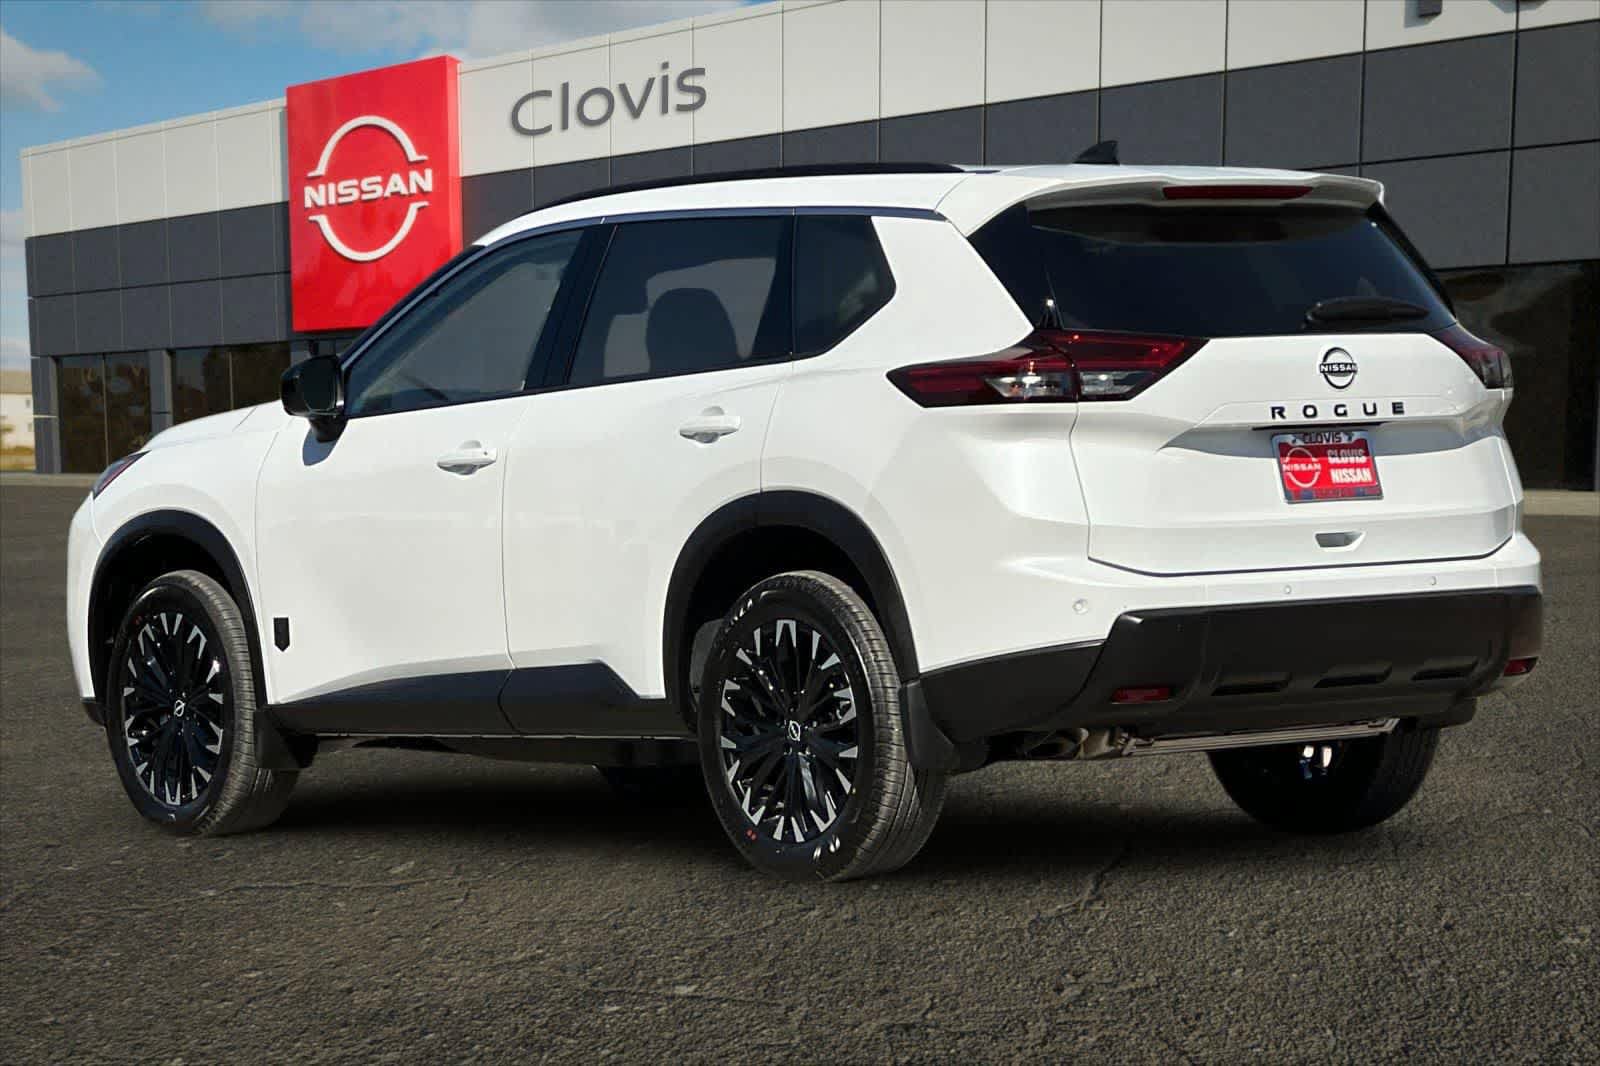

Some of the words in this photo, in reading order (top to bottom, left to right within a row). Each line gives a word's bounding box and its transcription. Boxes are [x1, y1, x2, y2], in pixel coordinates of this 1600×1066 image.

[511, 61, 707, 136] Clovis
[303, 168, 433, 209] NISSAN
[1320, 362, 1357, 373] NISSAN
[1270, 402, 1405, 420] ROGUE
[1303, 431, 1342, 444] CLOVIS
[1327, 449, 1367, 465] CLOVIS
[1282, 462, 1321, 472] NISSAN
[1330, 467, 1373, 484] NISSAN
